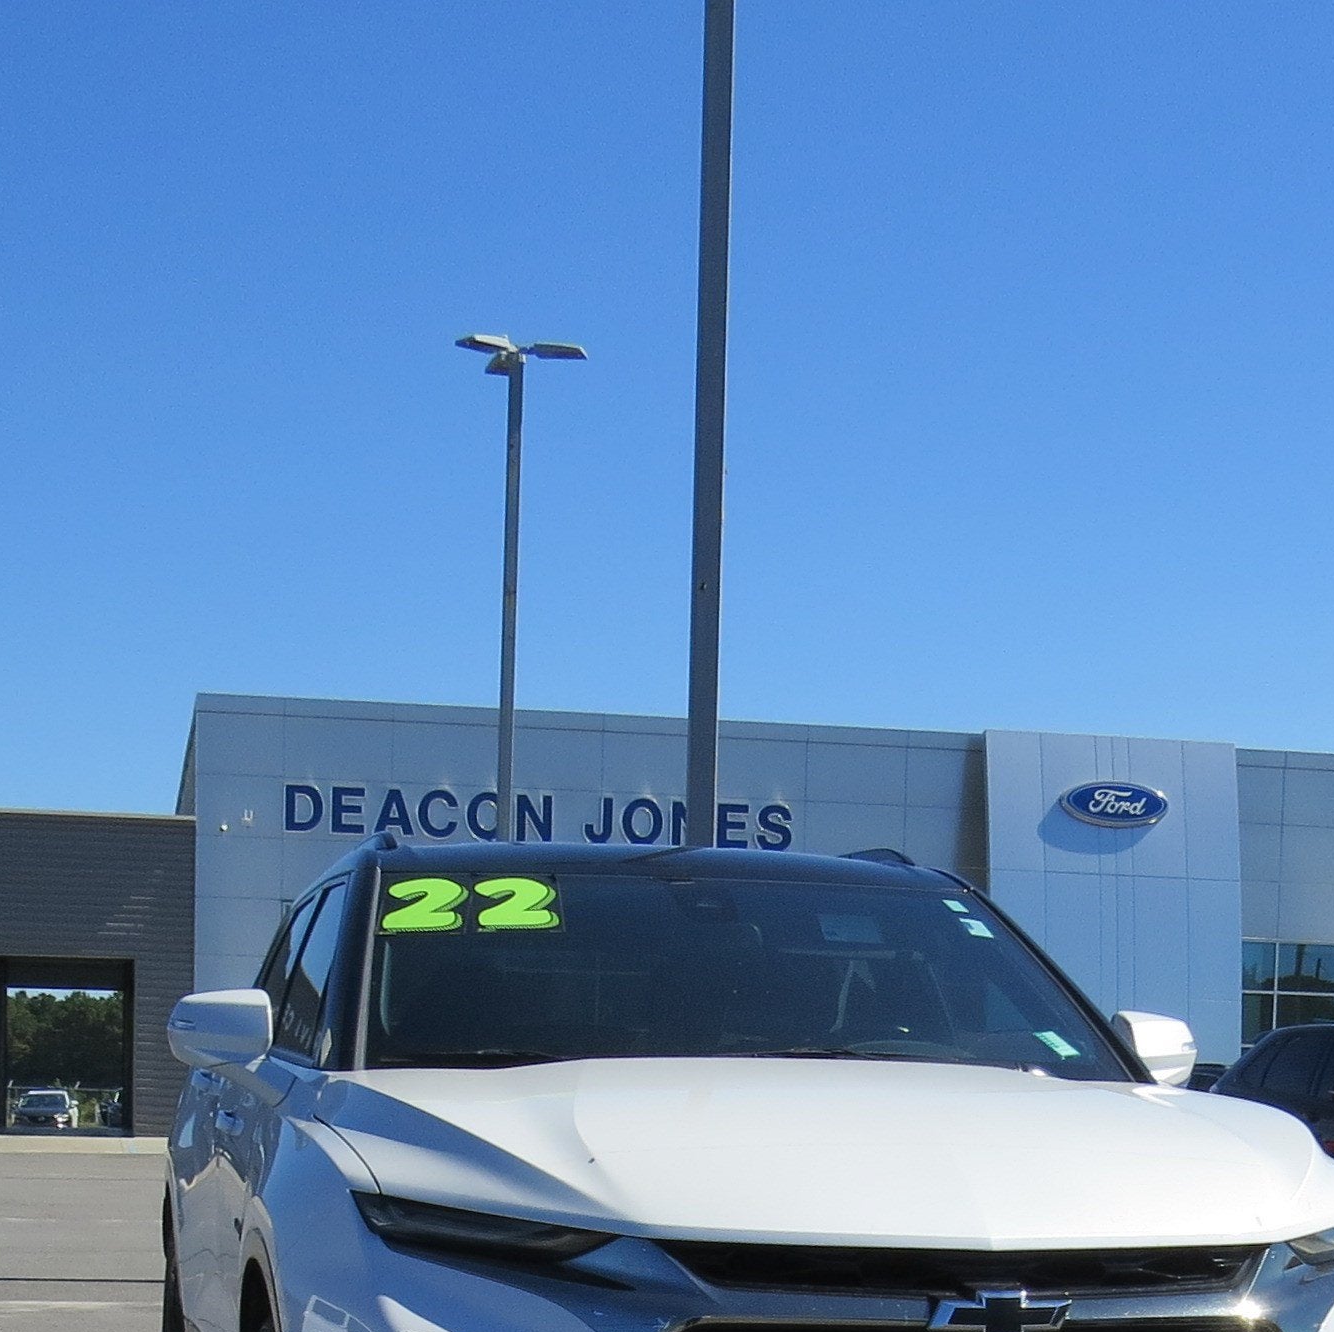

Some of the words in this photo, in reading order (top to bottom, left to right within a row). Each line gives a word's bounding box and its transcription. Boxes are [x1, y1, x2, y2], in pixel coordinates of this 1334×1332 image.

[284, 784, 554, 843] DEACON
[1088, 788, 1147, 816] Ford
[380, 876, 560, 932] 22
